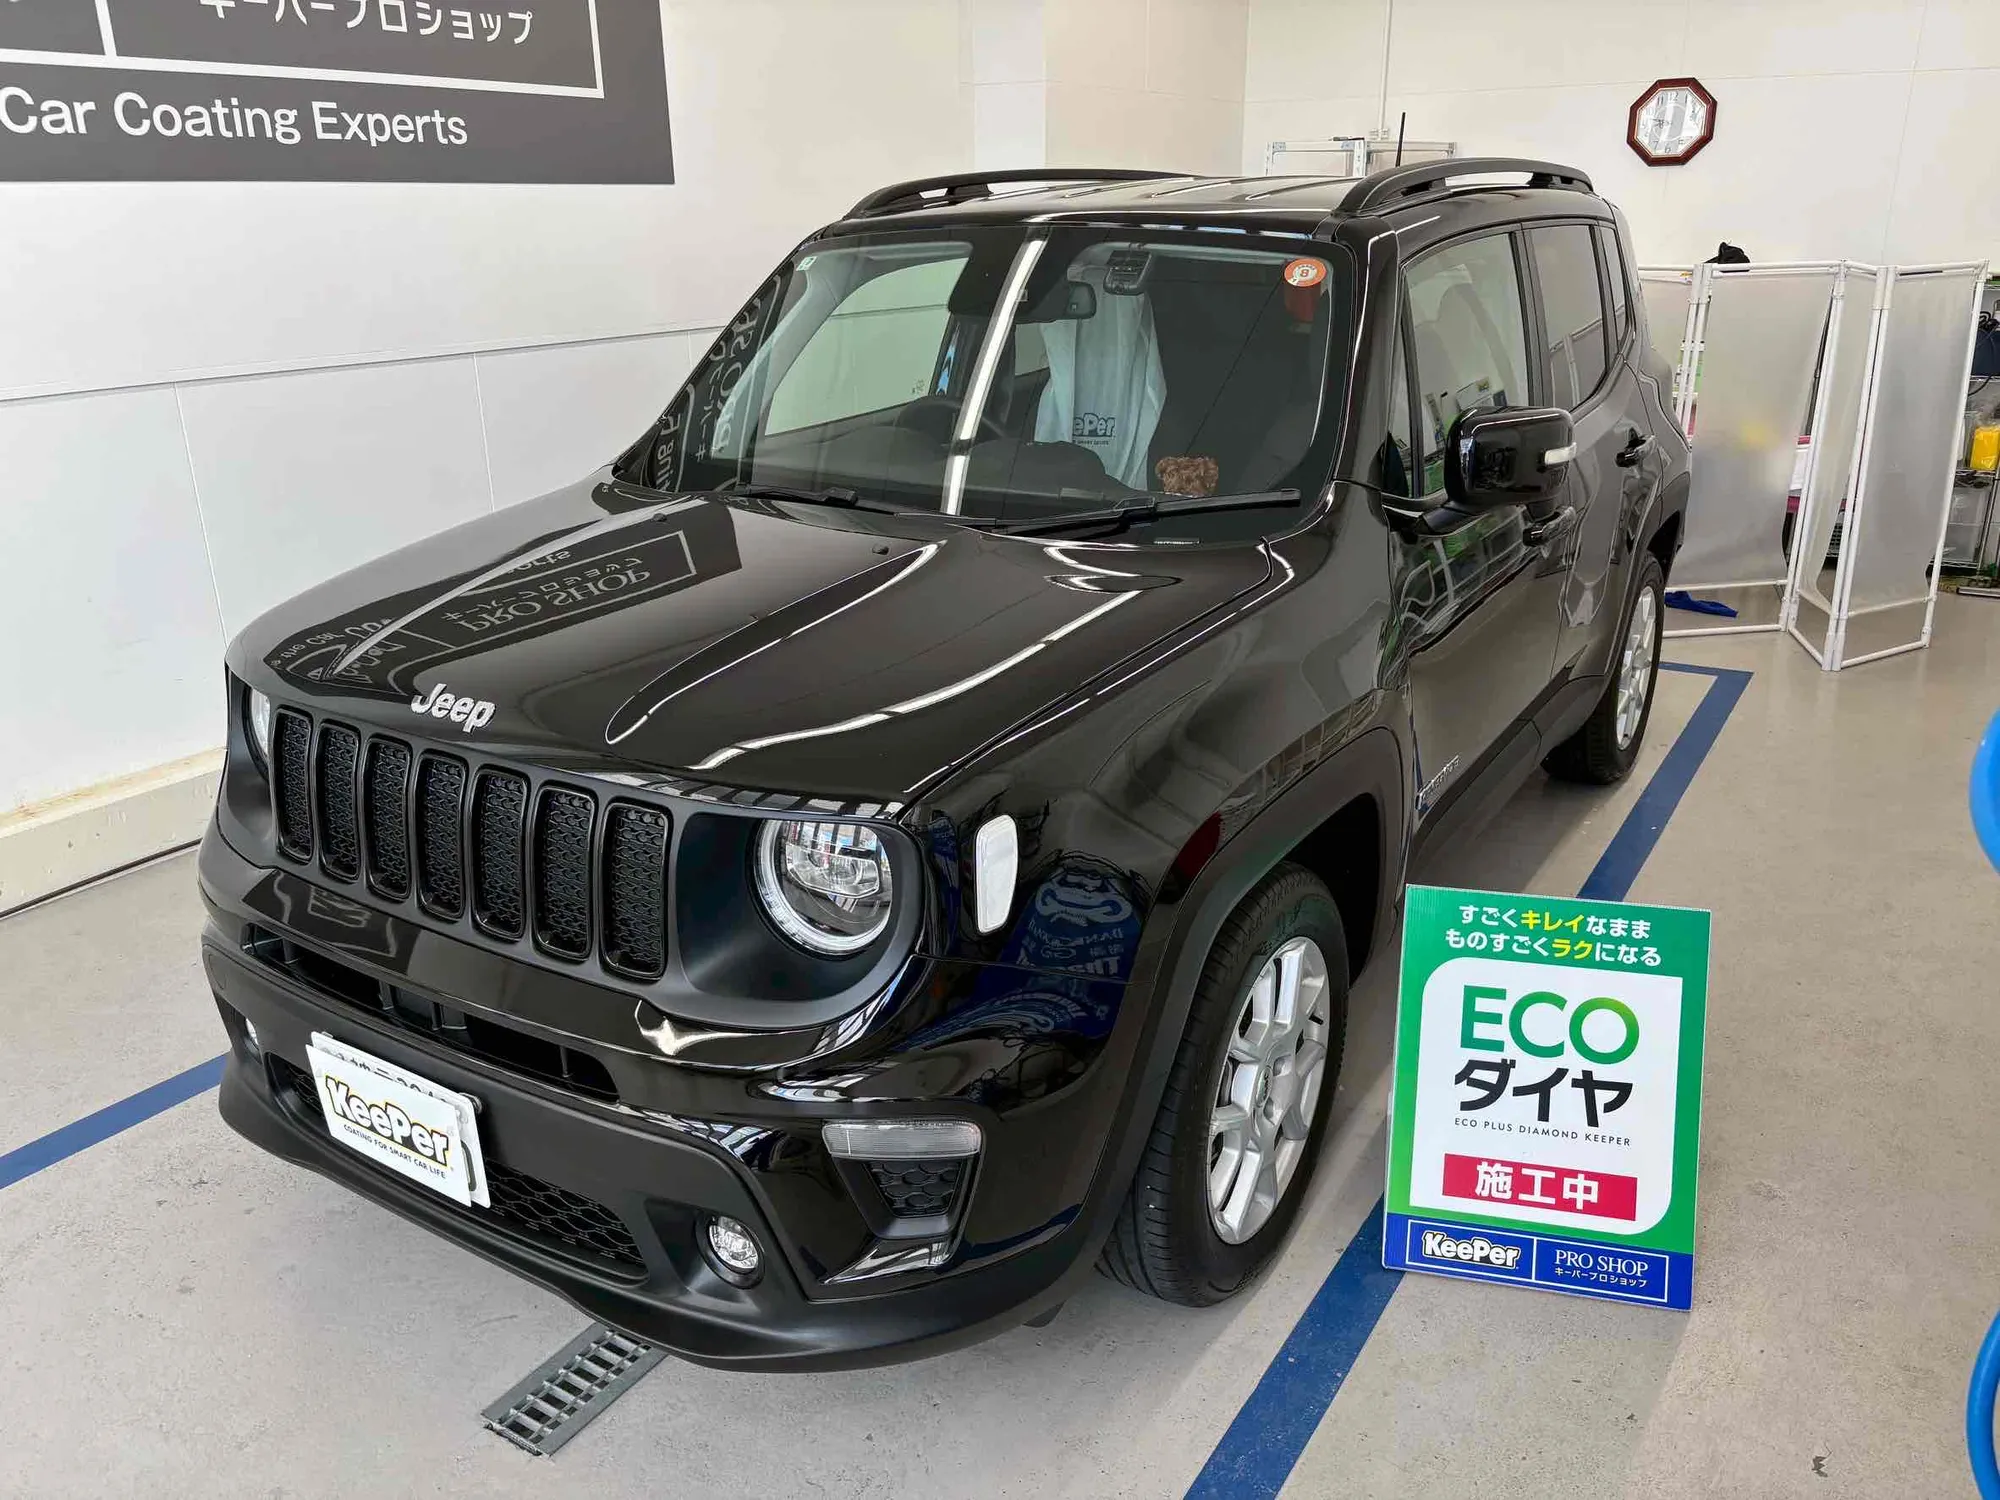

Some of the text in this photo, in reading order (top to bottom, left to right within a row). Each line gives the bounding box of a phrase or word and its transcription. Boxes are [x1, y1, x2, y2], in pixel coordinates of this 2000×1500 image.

[0, 86, 468, 147] Car Coating Experts
[1073, 412, 1116, 437] ePer
[411, 683, 496, 734] Jeep
[1458, 904, 1652, 939] すごくキレイなまま
[1445, 928, 1662, 967] ものすごくラクになる
[1460, 984, 1640, 1065] ECO
[1454, 1058, 1634, 1128] ダイヤ
[325, 1074, 449, 1167] KeePer
[1454, 1117, 1631, 1147] ECO PLUS DIAMOND KEEPER
[343, 1124, 446, 1179] COATING FOR SMART CAR LIFE
[1475, 1161, 1600, 1211] 施工中
[1422, 1230, 1521, 1269] KeePer
[1555, 1249, 1649, 1277] PRO SHOP
[1555, 1267, 1648, 1288] キーパープロショップ
